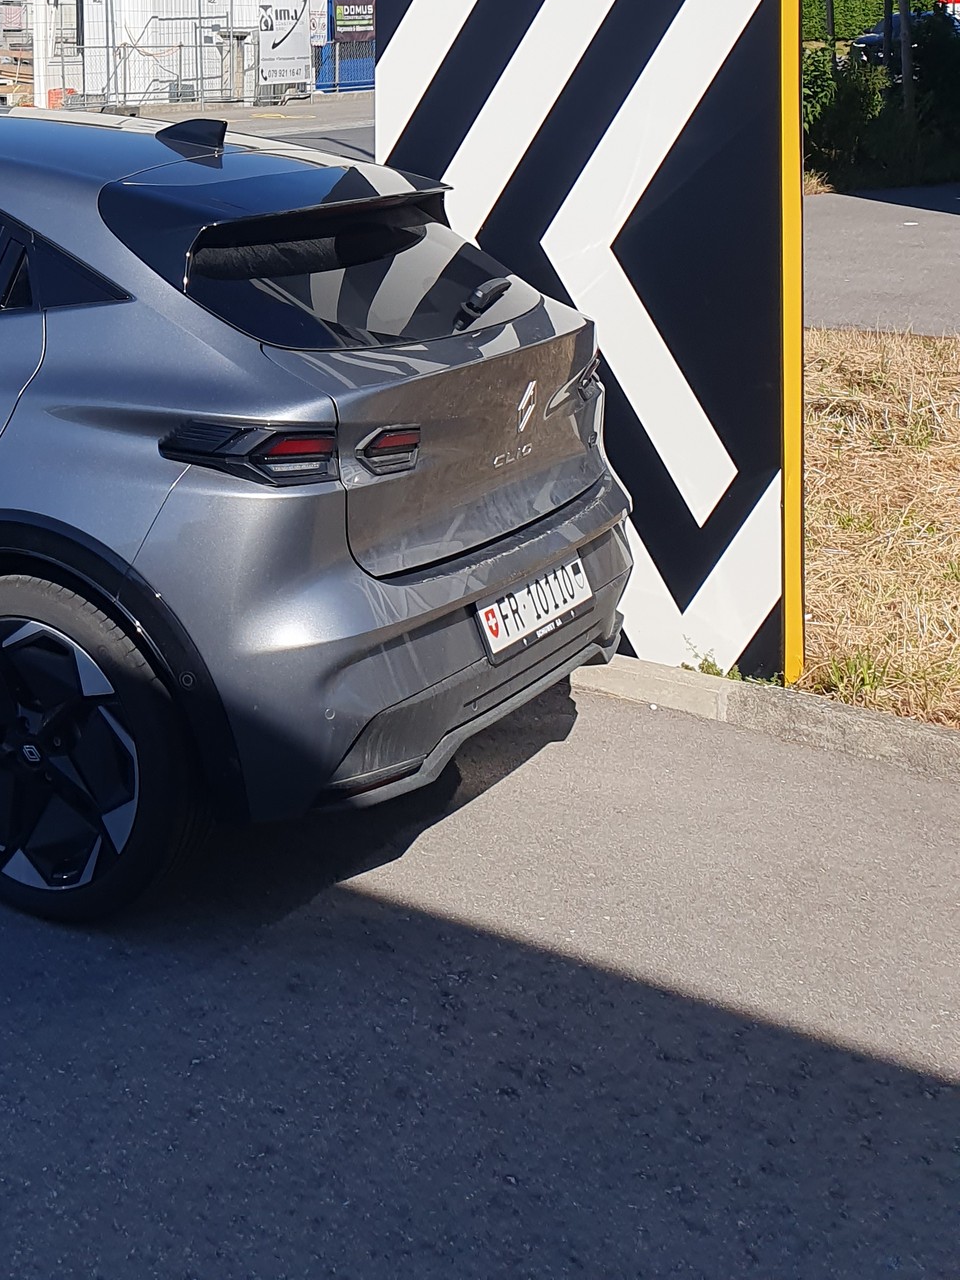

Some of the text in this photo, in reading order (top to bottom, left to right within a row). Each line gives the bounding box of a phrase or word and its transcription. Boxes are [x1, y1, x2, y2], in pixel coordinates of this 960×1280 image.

[275, 9, 298, 20] IMJ
[344, 5, 373, 14] DOMUS
[268, 68, 301, 78] 079 921 16 47
